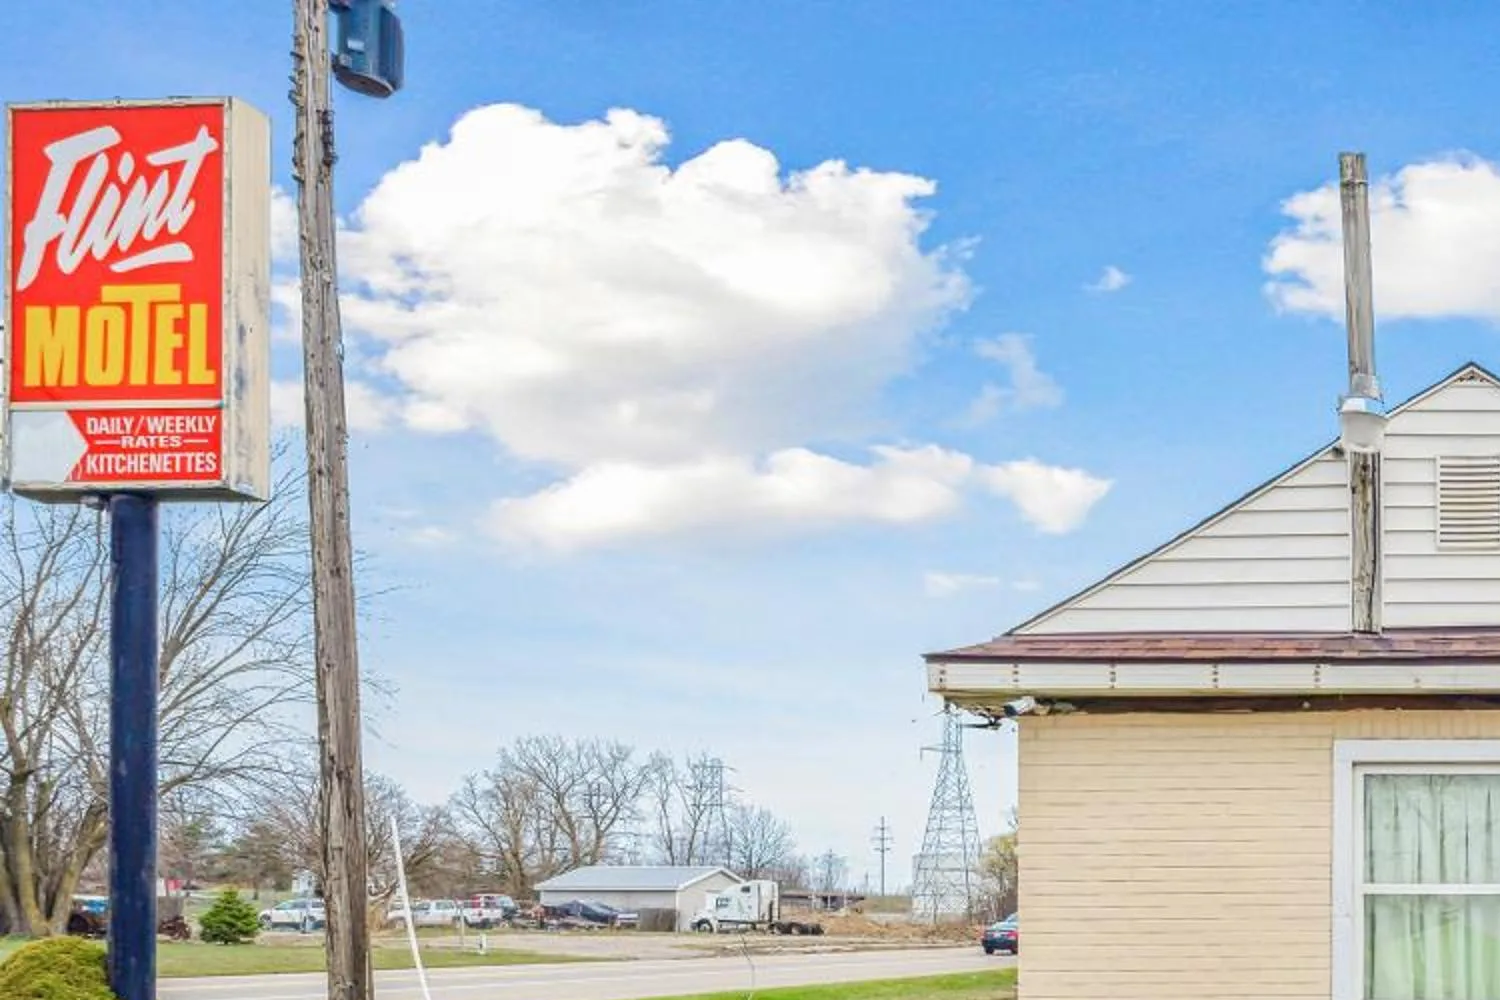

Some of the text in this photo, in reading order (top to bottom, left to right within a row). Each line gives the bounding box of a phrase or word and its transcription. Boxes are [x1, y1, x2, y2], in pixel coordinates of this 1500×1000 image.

[15, 125, 220, 291] Flint
[24, 283, 217, 387] MOTEL
[86, 452, 217, 475] KITCHENETTES
[120, 435, 183, 449] RATES
